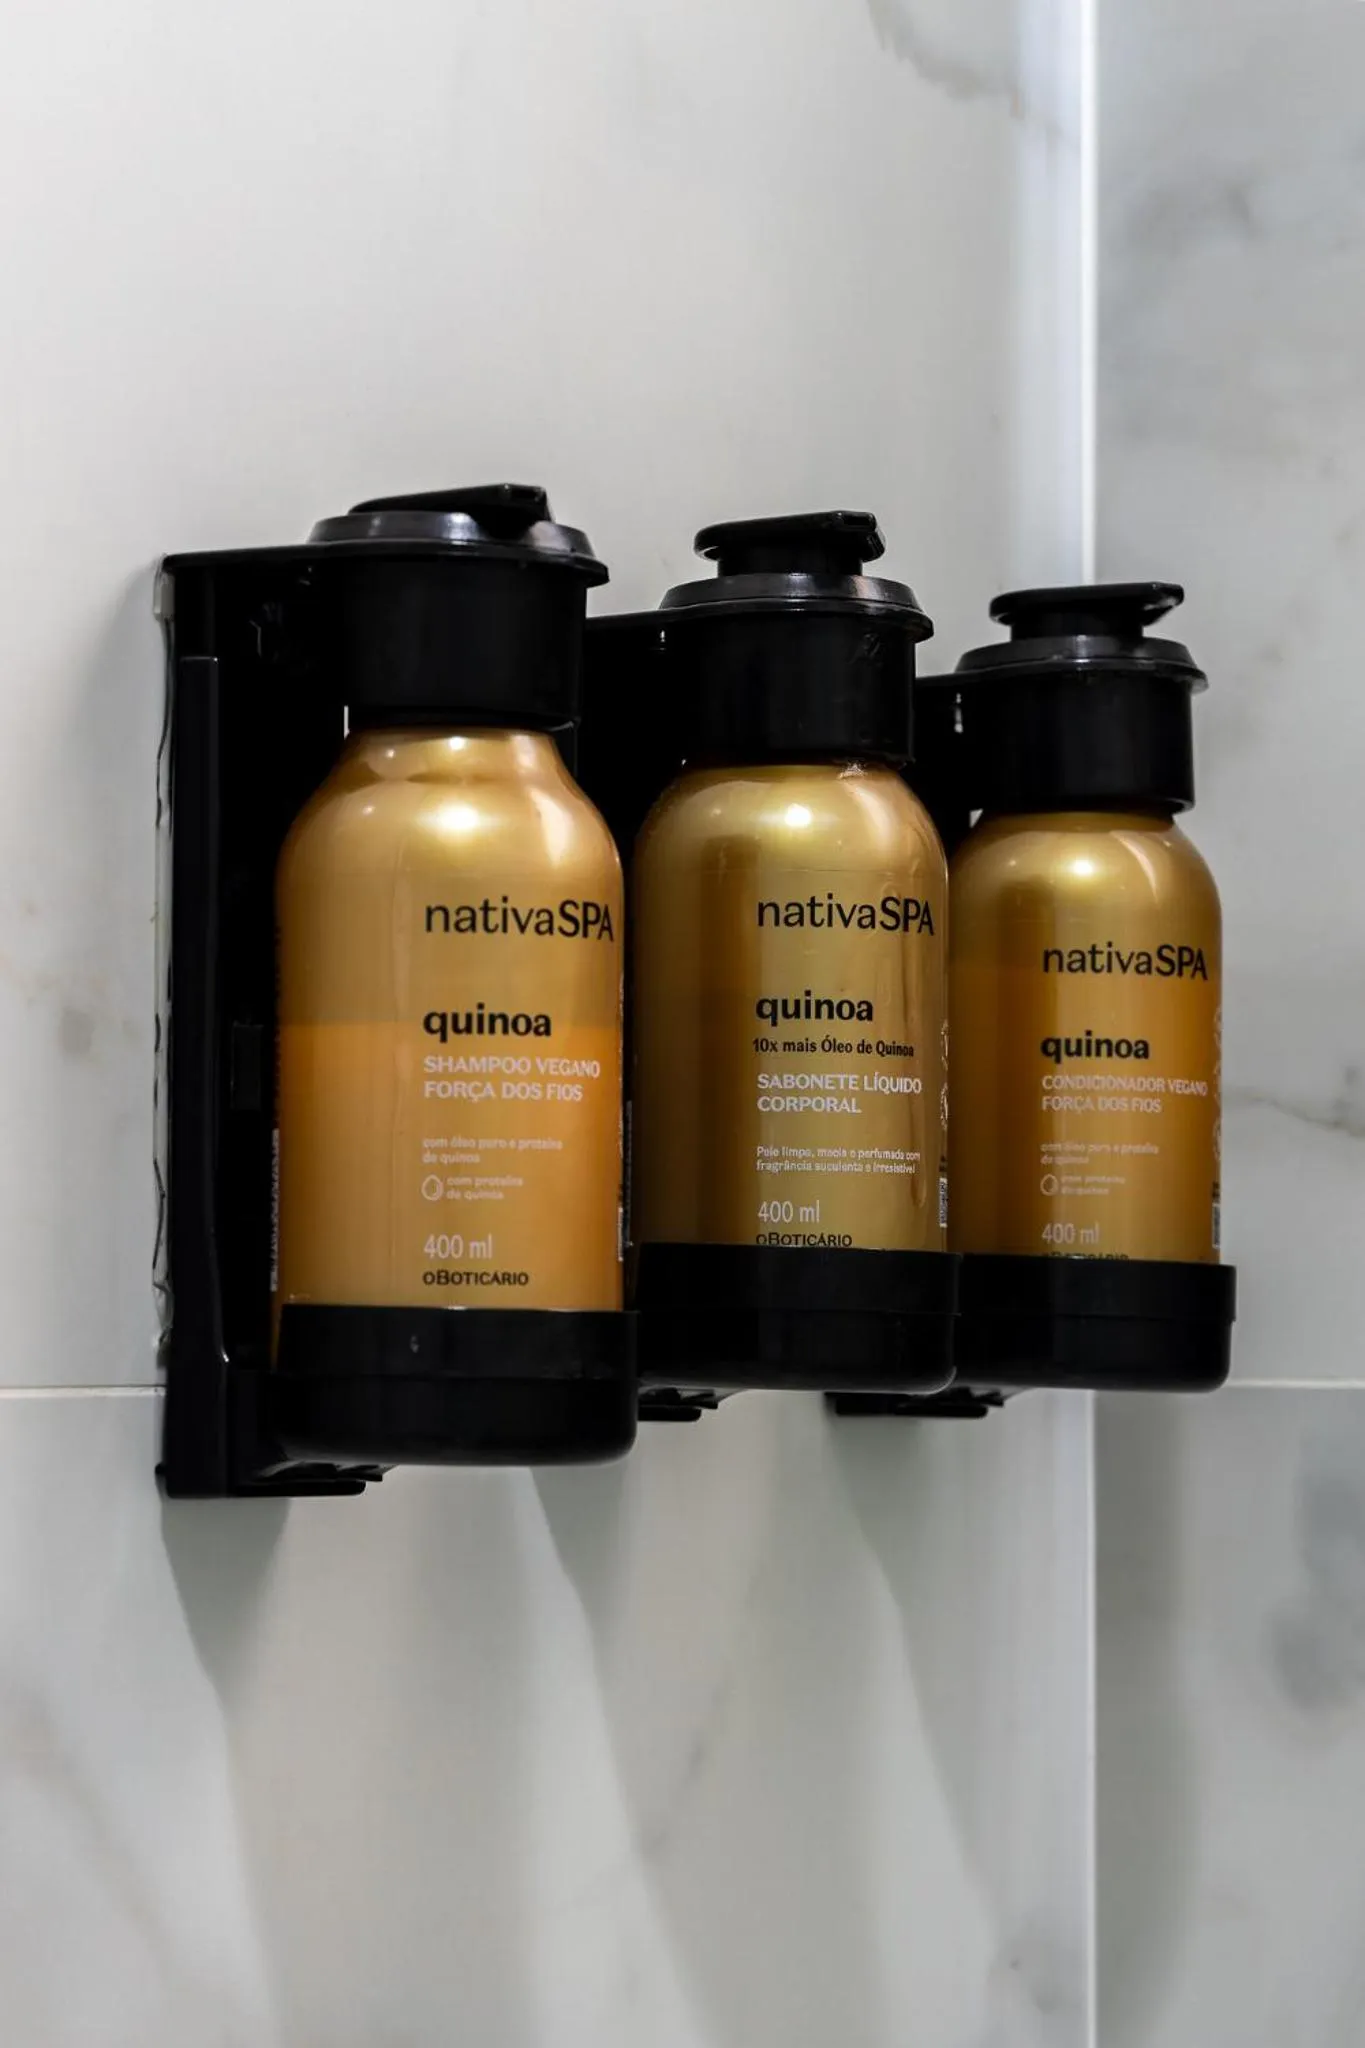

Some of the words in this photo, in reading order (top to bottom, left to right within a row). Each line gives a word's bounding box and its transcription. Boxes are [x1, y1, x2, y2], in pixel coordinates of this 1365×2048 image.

[425, 896, 614, 942] nativaSPA
[758, 893, 934, 936] nativaSPA
[1043, 941, 1208, 981] nativaSPA
[756, 990, 873, 1027] quinoa
[423, 1002, 551, 1043] quinoa
[753, 1038, 778, 1052] 10x
[783, 1038, 817, 1052] mais
[821, 1035, 853, 1053] Óleo
[857, 1039, 873, 1054] de
[876, 1041, 914, 1057] Quinoa
[1041, 1029, 1149, 1064] quinoa
[424, 1055, 531, 1075] SHAMPOO
[535, 1057, 600, 1079] VEGANO
[424, 1080, 496, 1102] FORÇA
[501, 1082, 541, 1099] DOS
[546, 1083, 583, 1101] FIOS
[757, 1073, 860, 1091] SABONETE
[863, 1072, 922, 1095] LÍQUIDO
[1042, 1075, 1165, 1092] CONDICIONADOR
[1167, 1079, 1208, 1096] VEGANO
[757, 1096, 862, 1113] CORPORAL
[1042, 1096, 1094, 1115] FORÇA
[1099, 1098, 1128, 1112] DOS
[1132, 1099, 1162, 1113] FIOS
[422, 1151, 437, 1163] de
[758, 1201, 793, 1223] 400
[800, 1200, 820, 1223] ml
[1042, 1223, 1075, 1244] 400
[1081, 1222, 1099, 1244] ml
[424, 1234, 463, 1259] 400
[470, 1233, 493, 1259] ml
